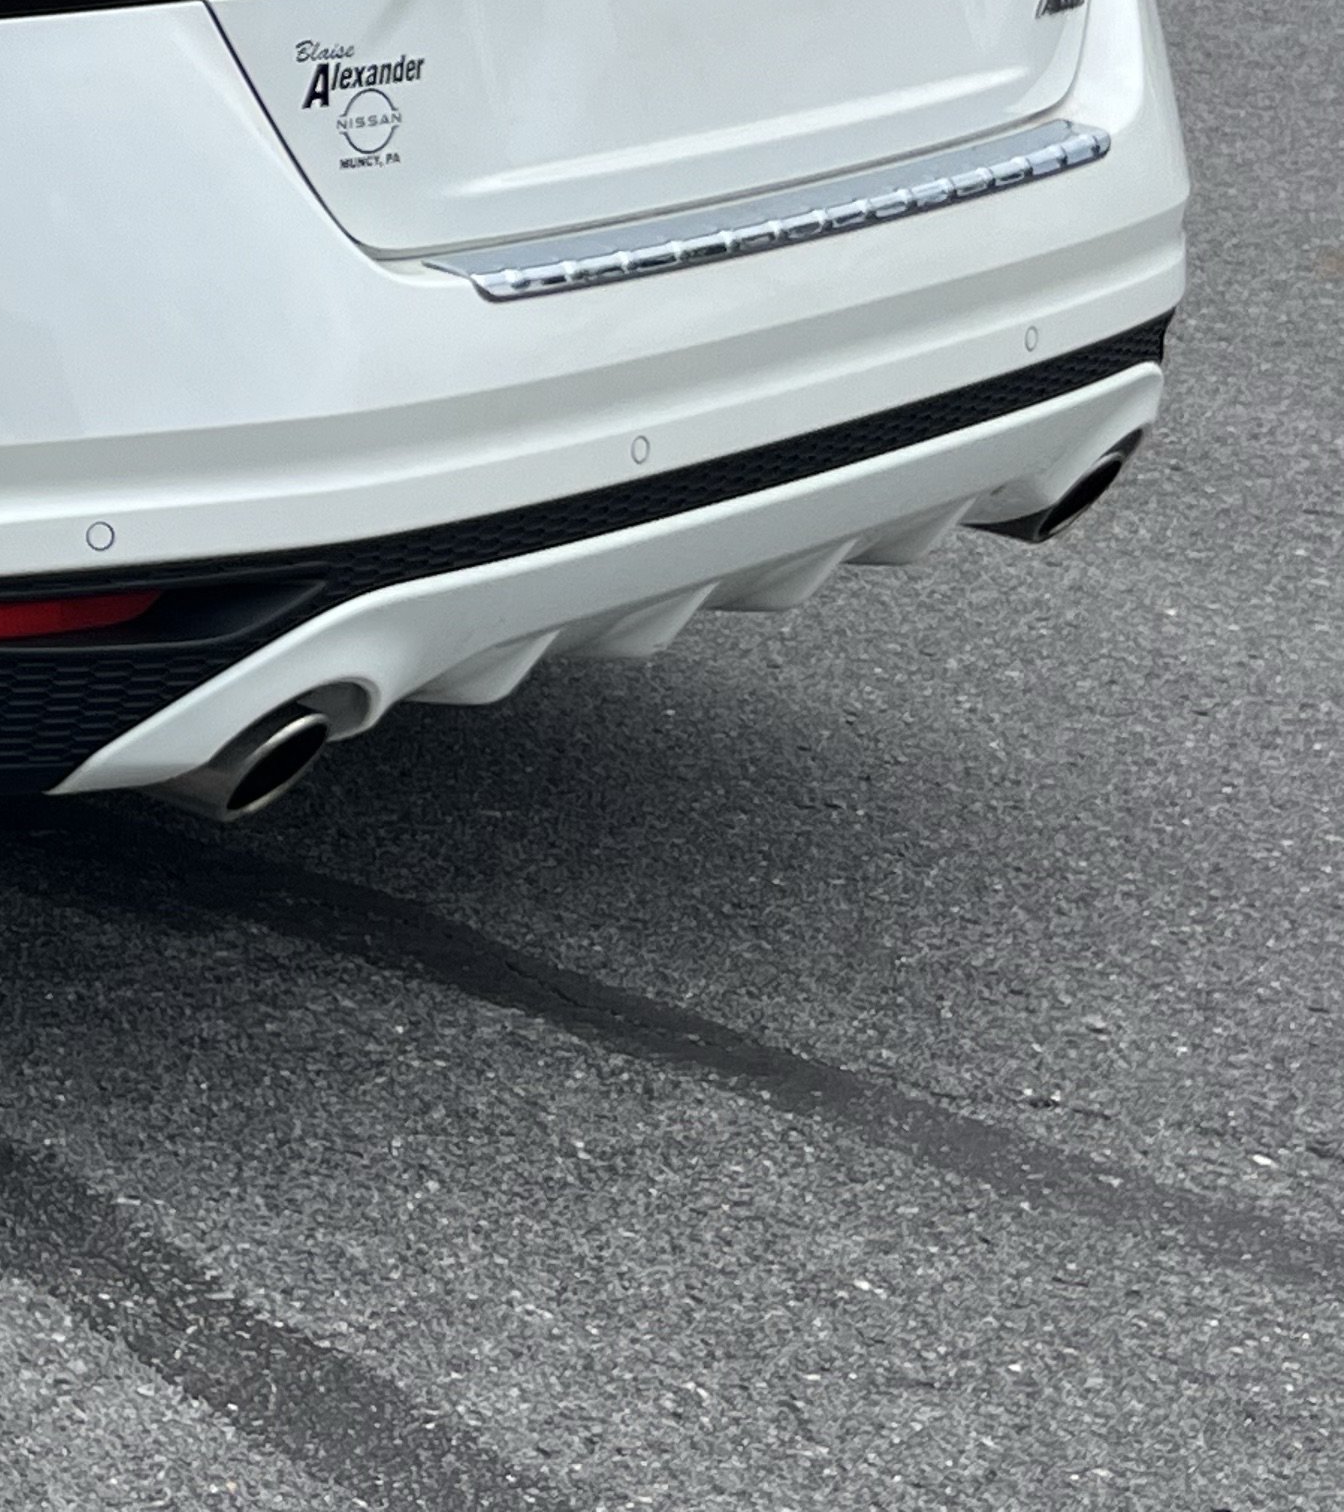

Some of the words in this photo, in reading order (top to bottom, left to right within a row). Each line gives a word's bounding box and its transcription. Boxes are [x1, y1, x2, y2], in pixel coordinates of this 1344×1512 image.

[295, 39, 355, 63] Blaise
[301, 53, 425, 109] Alexander
[336, 112, 402, 130] NISSAN
[385, 152, 401, 165] PA
